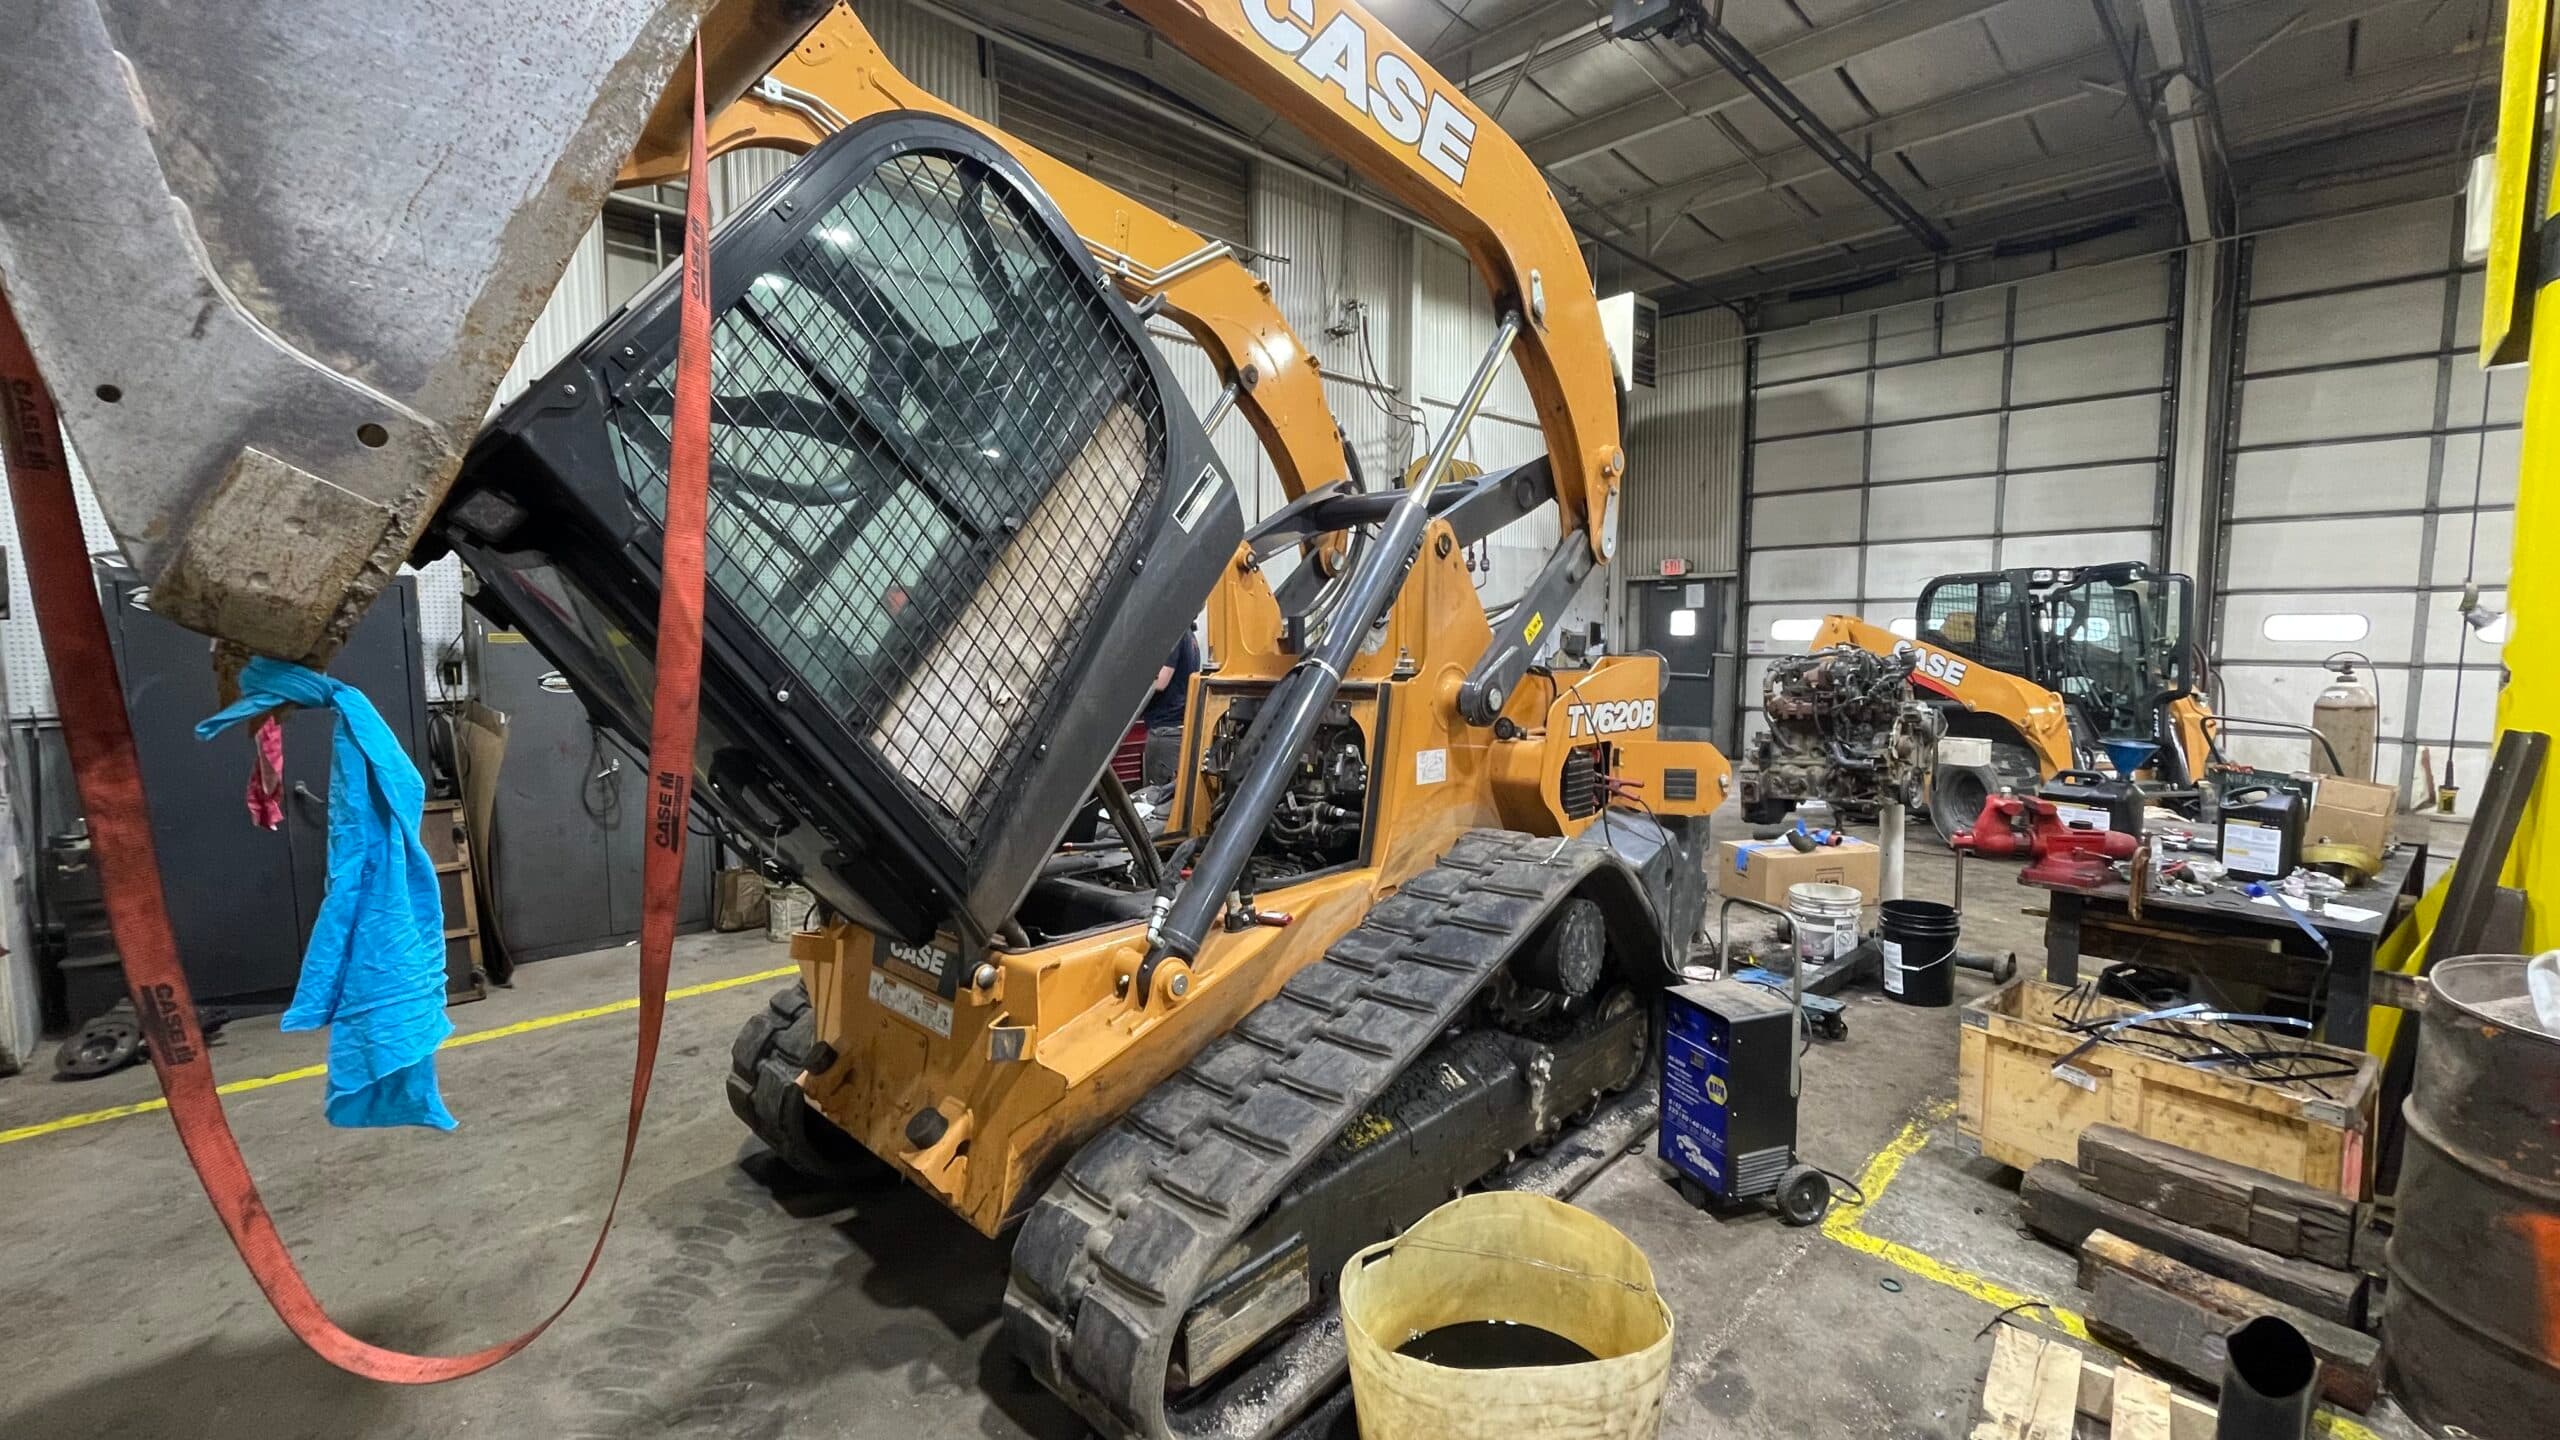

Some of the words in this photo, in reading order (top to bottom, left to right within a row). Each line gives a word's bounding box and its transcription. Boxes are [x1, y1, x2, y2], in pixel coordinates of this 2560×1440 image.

[1240, 0, 1477, 188] CASE
[12, 378, 45, 447] CASE
[1567, 698, 1657, 738] TV620B
[655, 791, 672, 849] CASE
[890, 941, 947, 976] CASE
[156, 983, 187, 1043] CASE
